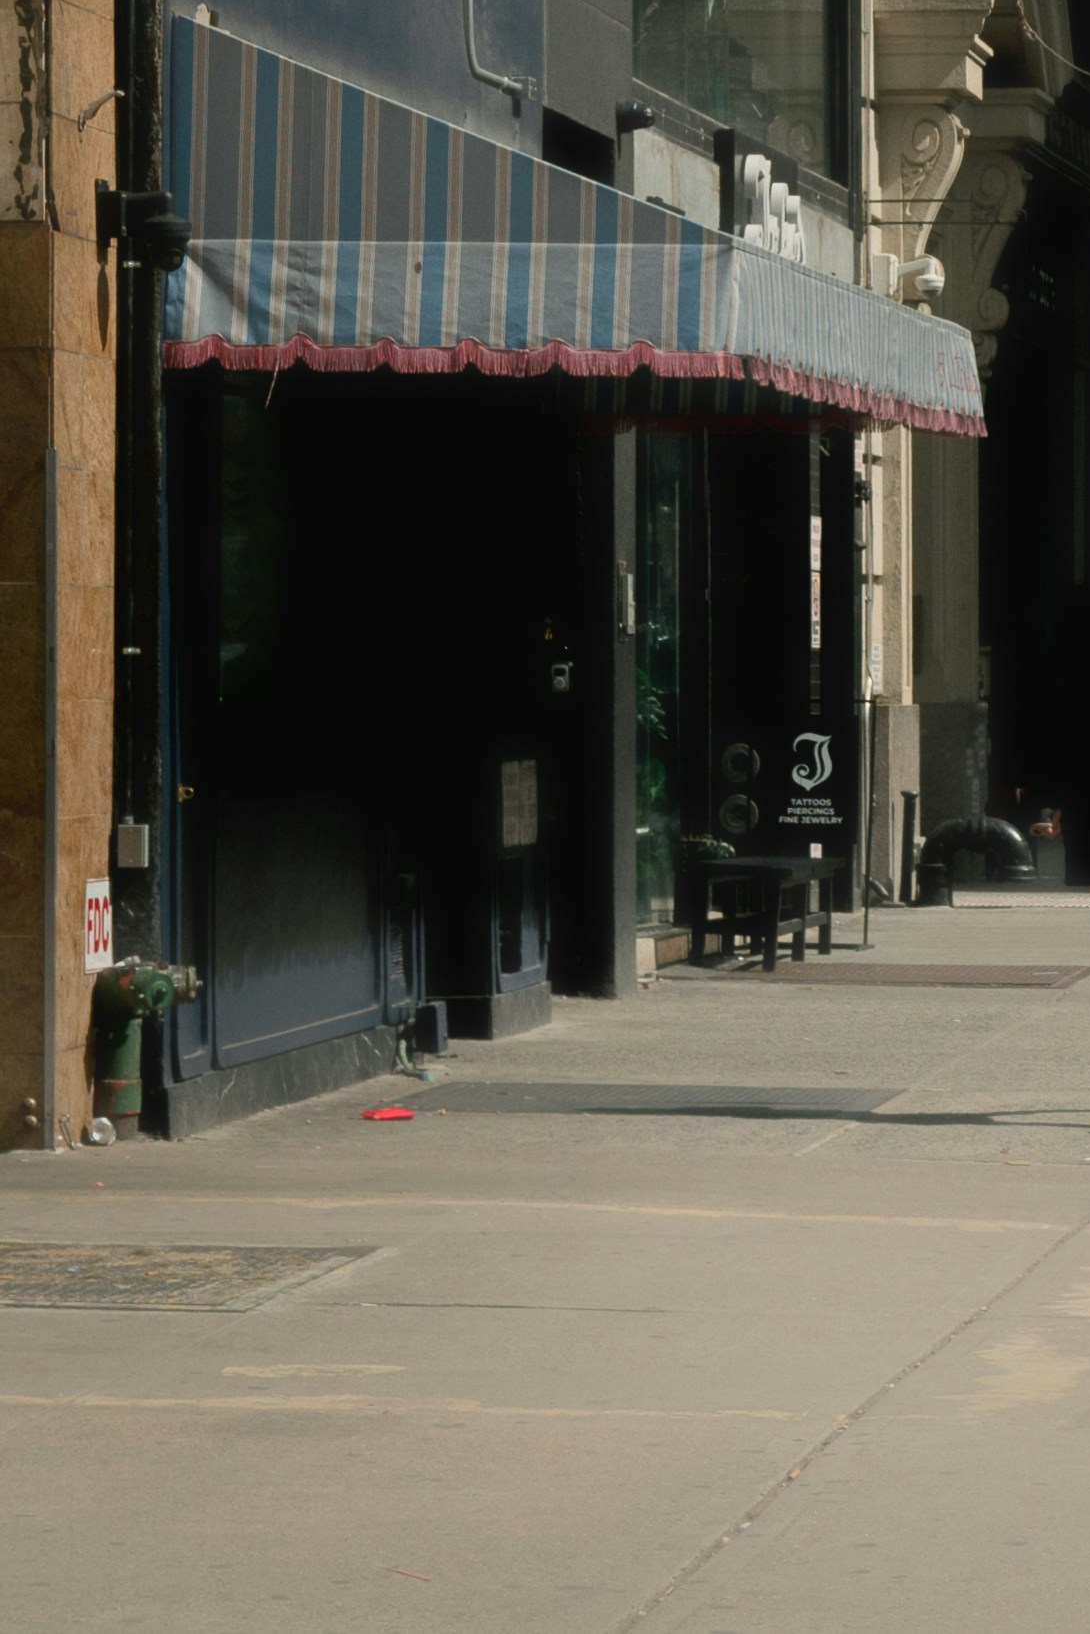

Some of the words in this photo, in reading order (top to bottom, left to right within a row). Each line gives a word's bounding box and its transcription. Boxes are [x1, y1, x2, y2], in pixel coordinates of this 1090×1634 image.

[790, 798, 832, 806] TATTOOS
[787, 807, 835, 815] PIERCINGS
[778, 816, 799, 824] FINE
[801, 816, 843, 824] JEWELRY
[87, 895, 110, 955] FDC
